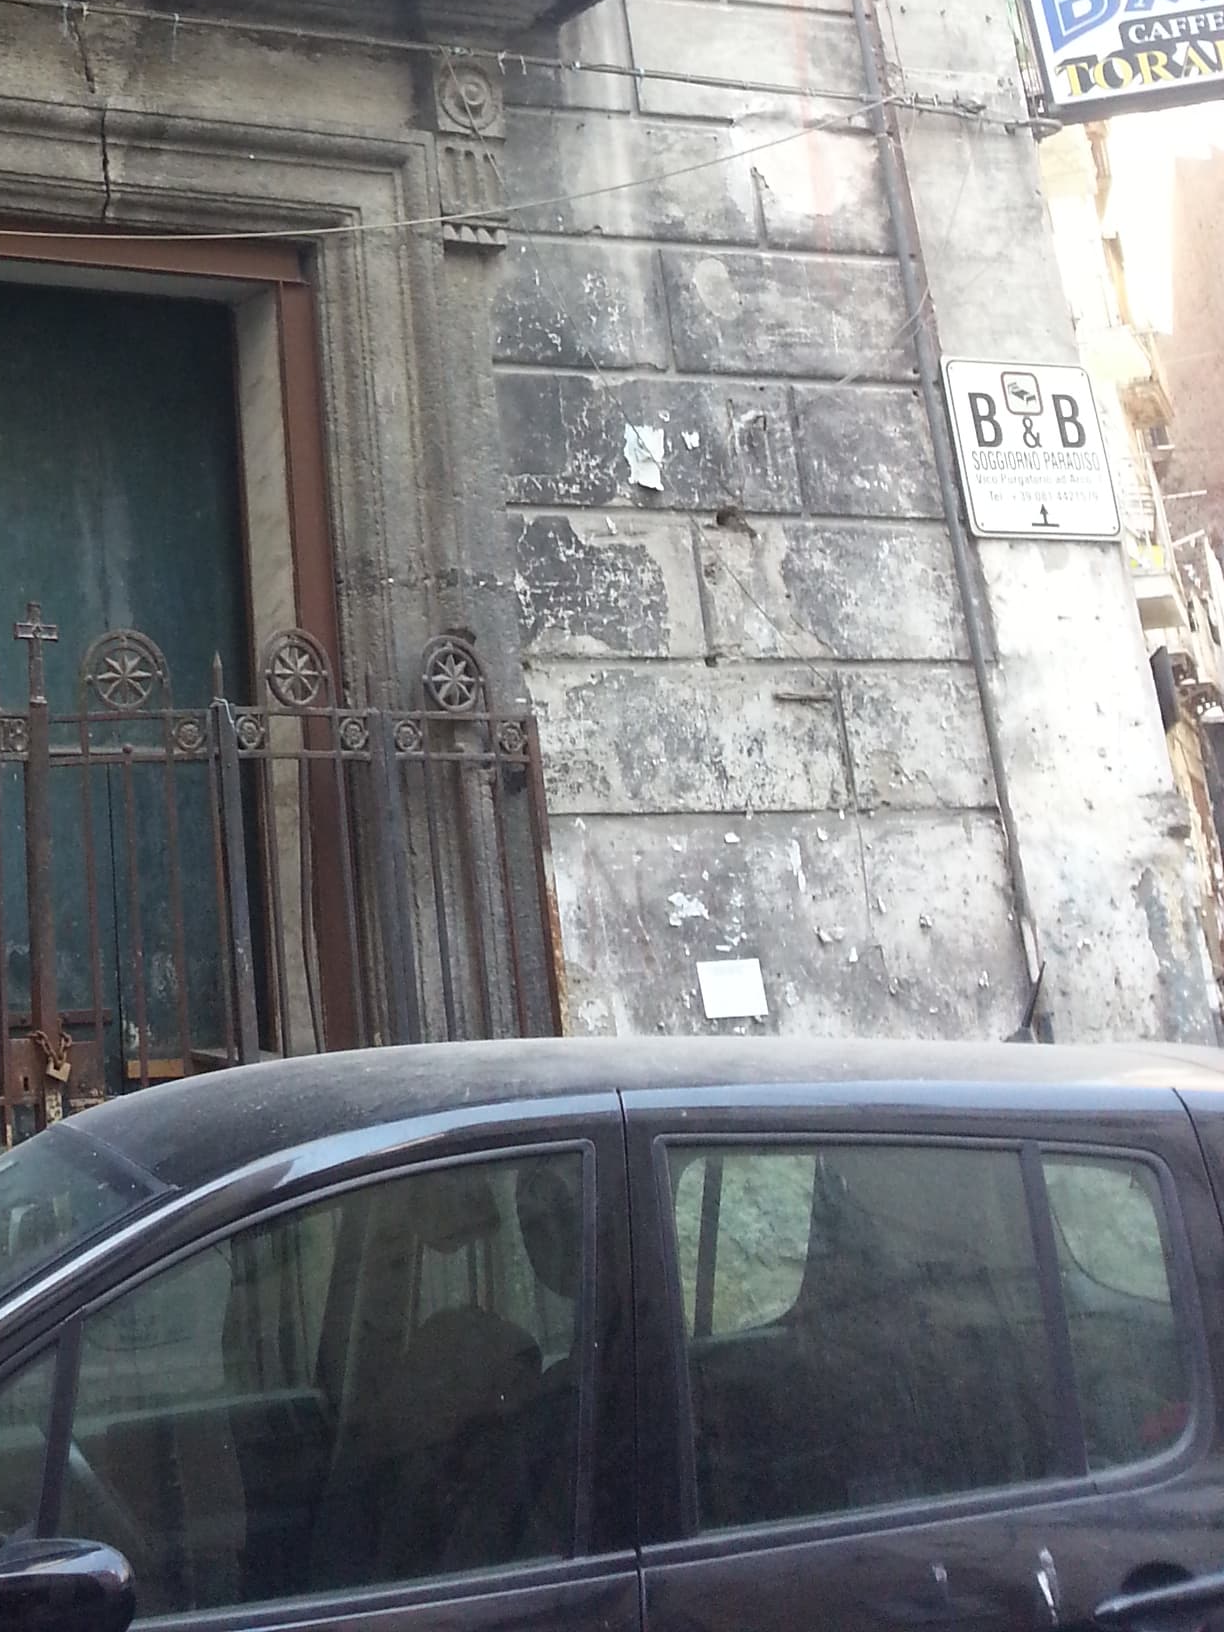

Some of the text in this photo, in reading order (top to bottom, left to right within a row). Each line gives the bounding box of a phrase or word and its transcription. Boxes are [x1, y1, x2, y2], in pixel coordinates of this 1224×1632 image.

[968, 392, 1086, 448] B & B
[971, 450, 1101, 471] SOGGIORNO PARADISO
